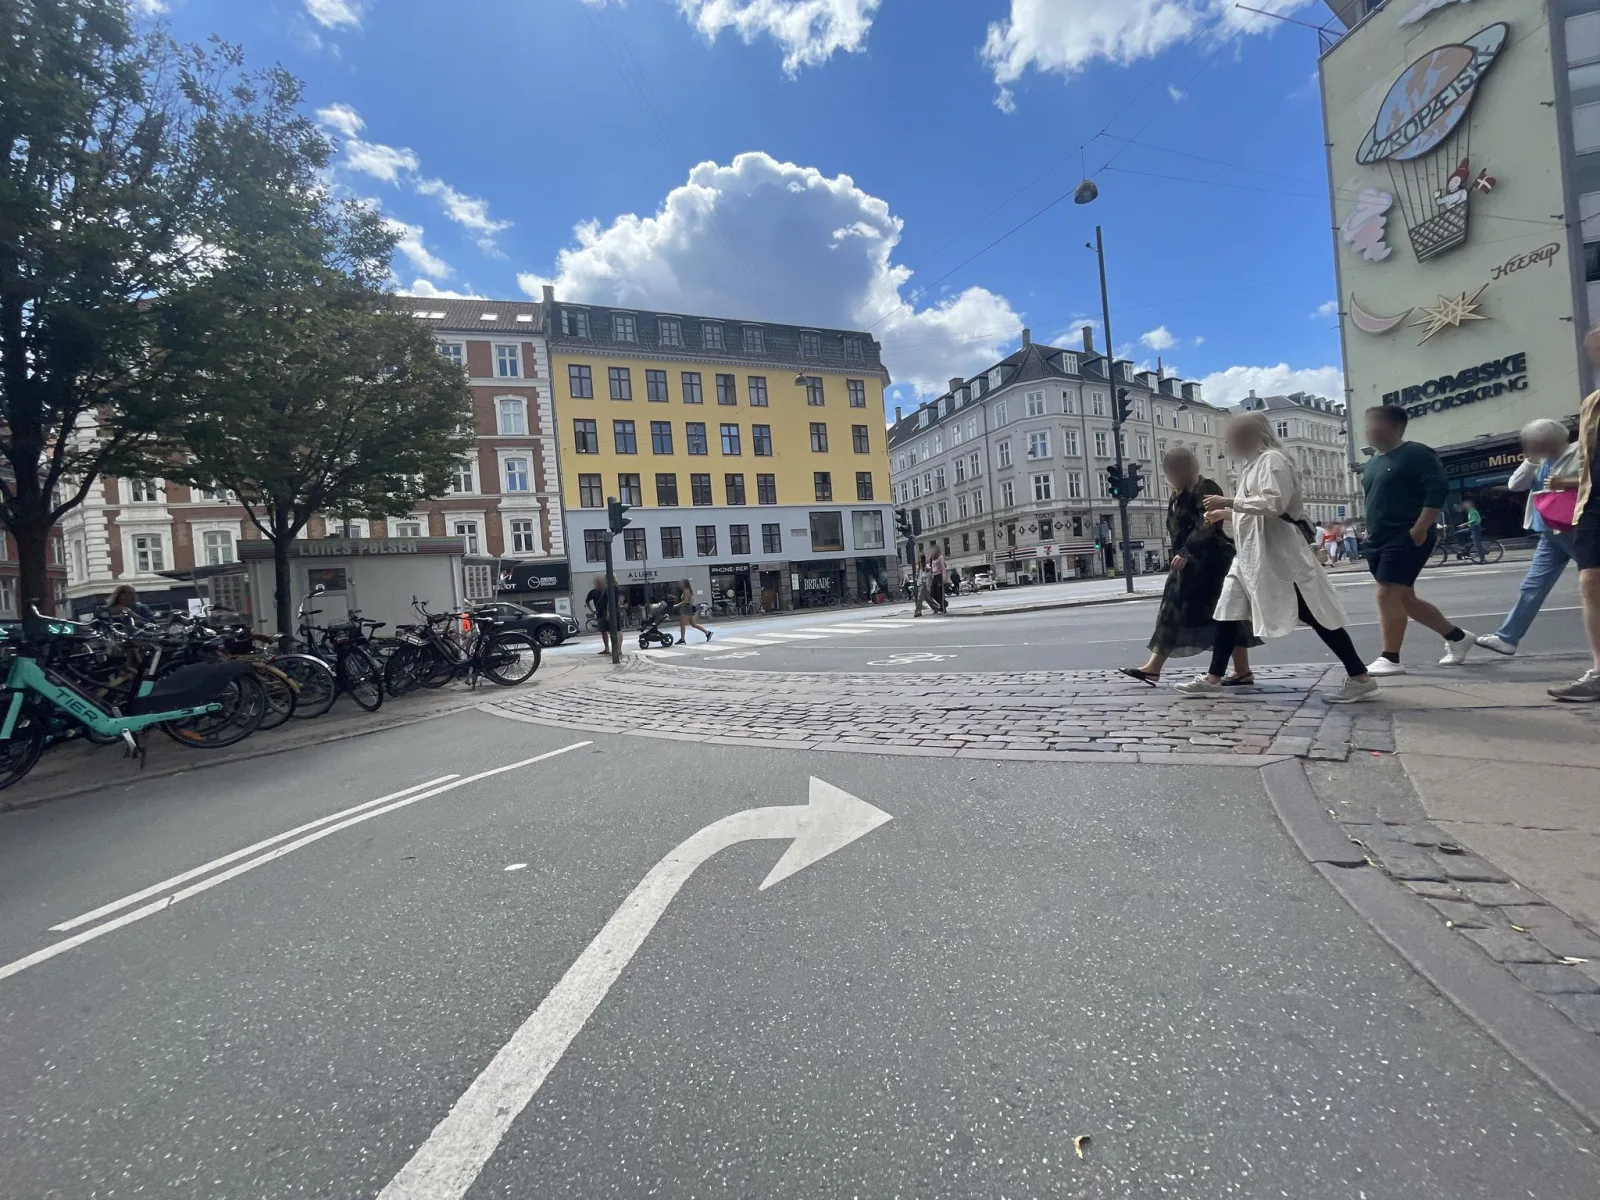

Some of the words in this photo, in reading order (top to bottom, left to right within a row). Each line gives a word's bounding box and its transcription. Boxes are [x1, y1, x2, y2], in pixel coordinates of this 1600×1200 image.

[1491, 242, 1560, 280] HEERUP
[1382, 352, 1526, 407] EUROPÆISKE
[1405, 375, 1528, 420] SEFORSIKRING
[1035, 511, 1056, 519] TOKYO
[804, 577, 831, 590] BRIGADE
[56, 688, 98, 722] TIER
